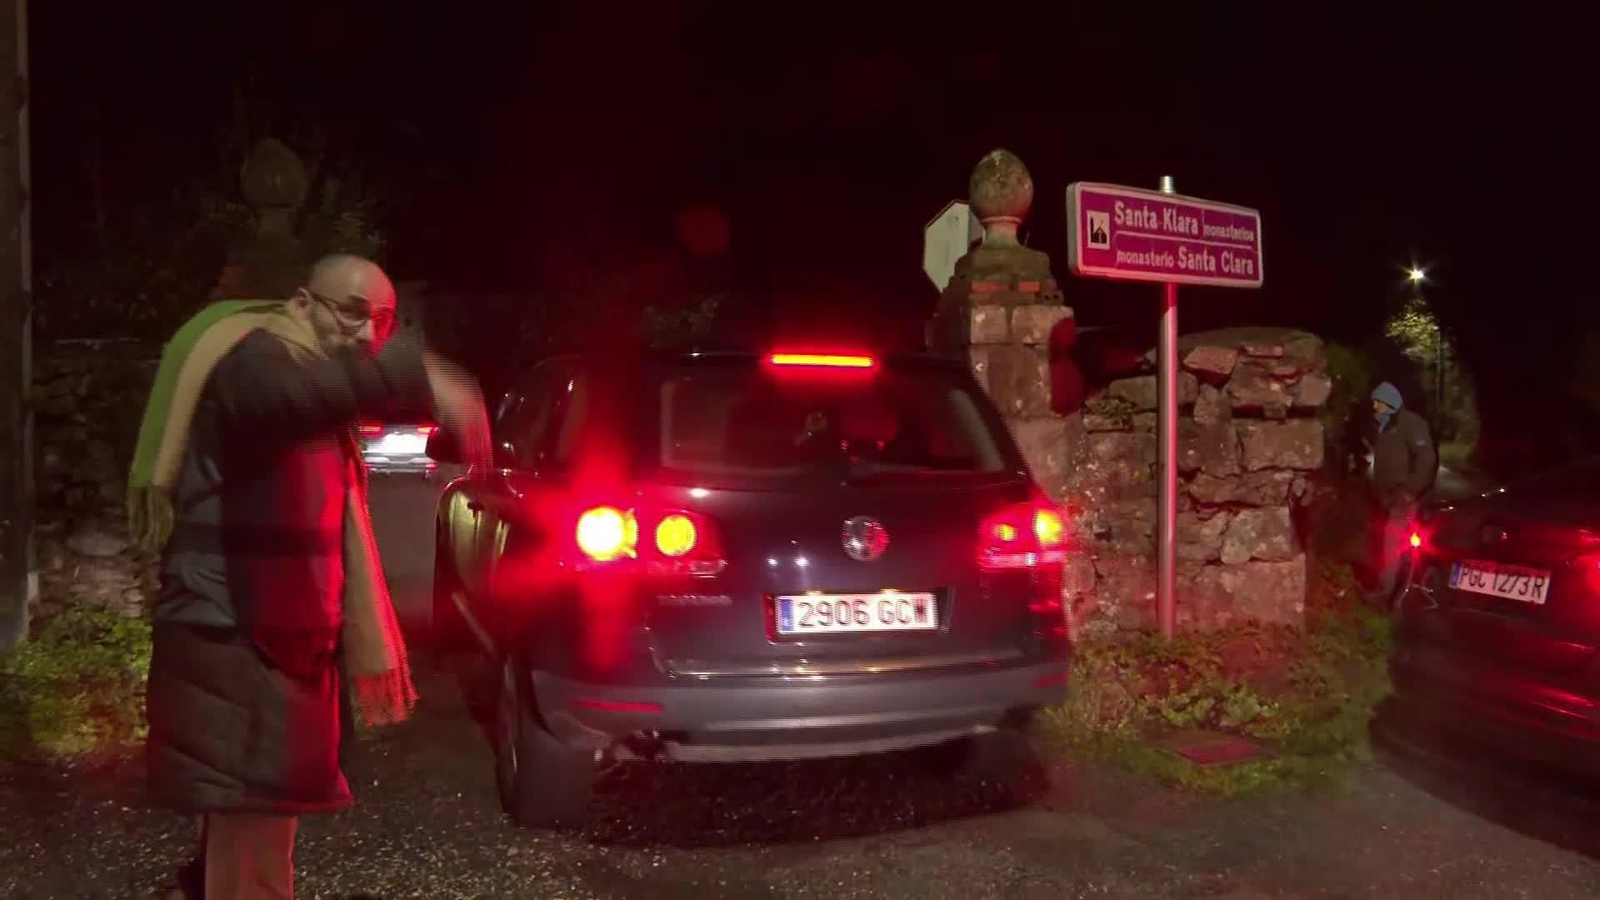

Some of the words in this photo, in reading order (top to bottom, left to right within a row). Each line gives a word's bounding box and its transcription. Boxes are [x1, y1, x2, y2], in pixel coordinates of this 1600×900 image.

[1114, 201, 1158, 230] Santa
[1163, 207, 1199, 235] Klara
[1116, 249, 1174, 269] monasterio
[1178, 246, 1217, 272] Santa
[1221, 250, 1254, 275] Clara
[798, 600, 870, 627] 2906
